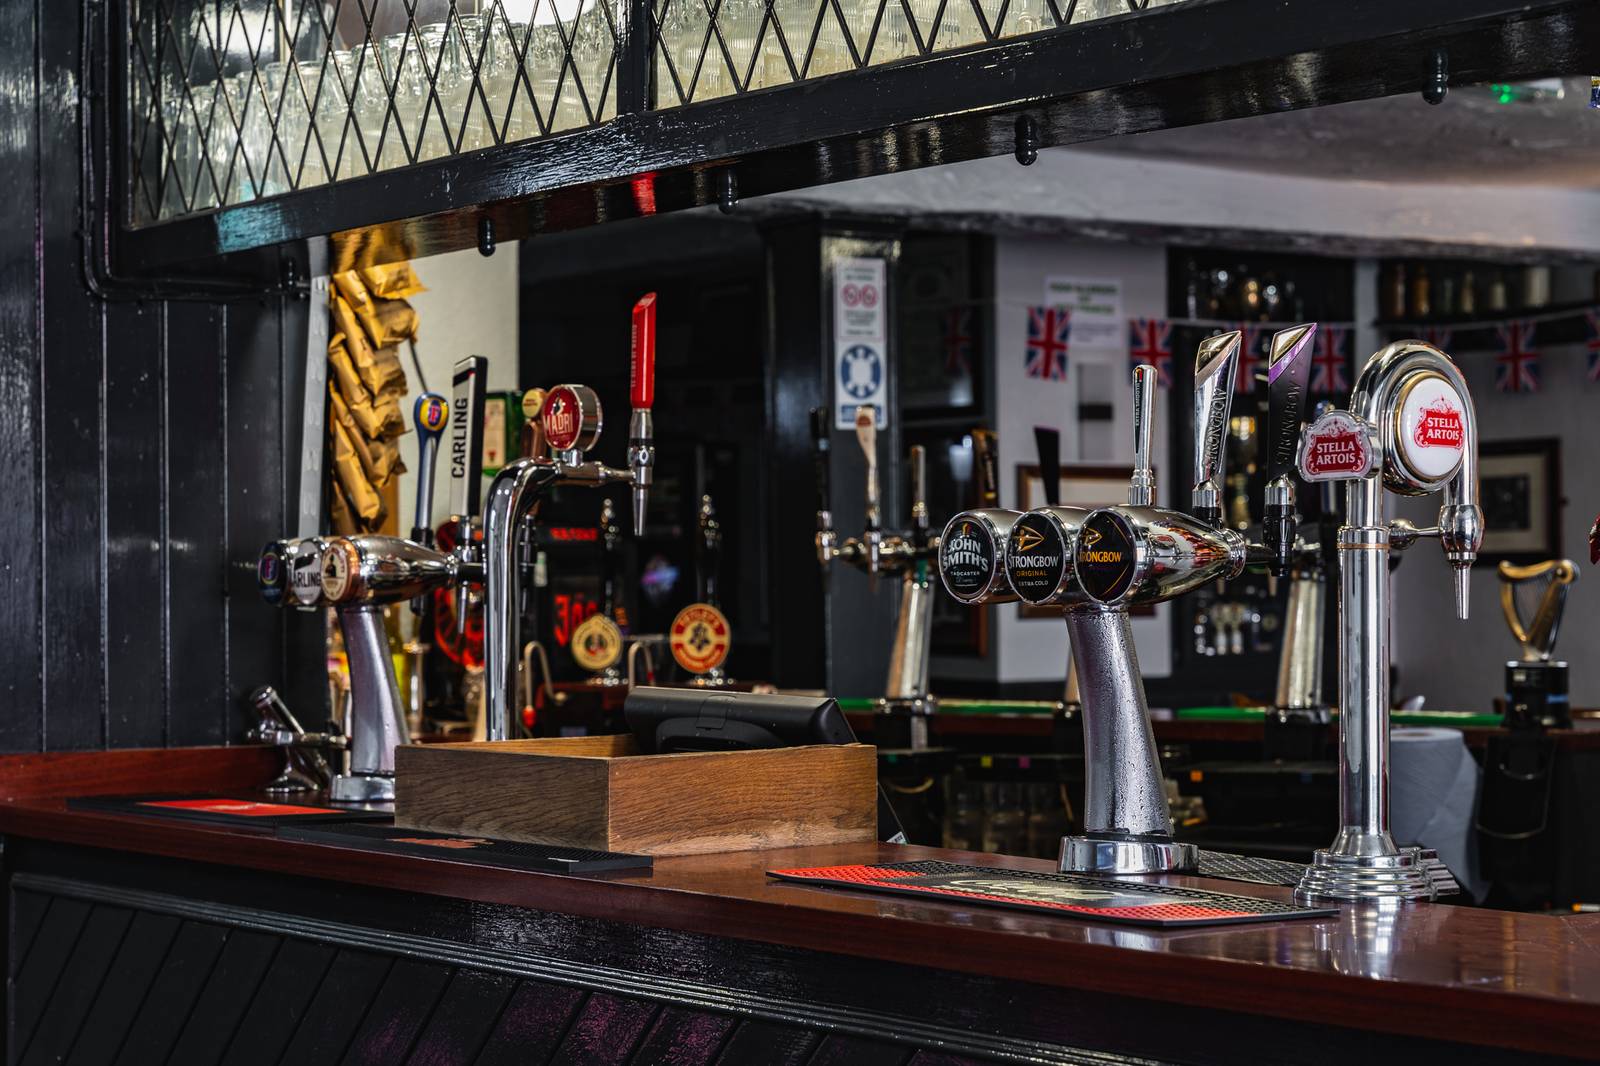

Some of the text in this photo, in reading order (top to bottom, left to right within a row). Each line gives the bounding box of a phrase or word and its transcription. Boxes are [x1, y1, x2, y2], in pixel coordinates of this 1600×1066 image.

[1205, 386, 1228, 469] STRONGBOW
[1275, 382, 1302, 465] STRONGBOW
[1427, 417, 1459, 429] STELLA
[451, 398, 468, 478] CARLING
[1426, 429, 1460, 440] ARTOIS
[1317, 442, 1355, 453] STELLA
[1316, 453, 1356, 465] ARTOIS
[947, 538, 981, 553] JOHN
[942, 551, 988, 572] SMITH'S
[1008, 554, 1058, 568] STRONGBOW
